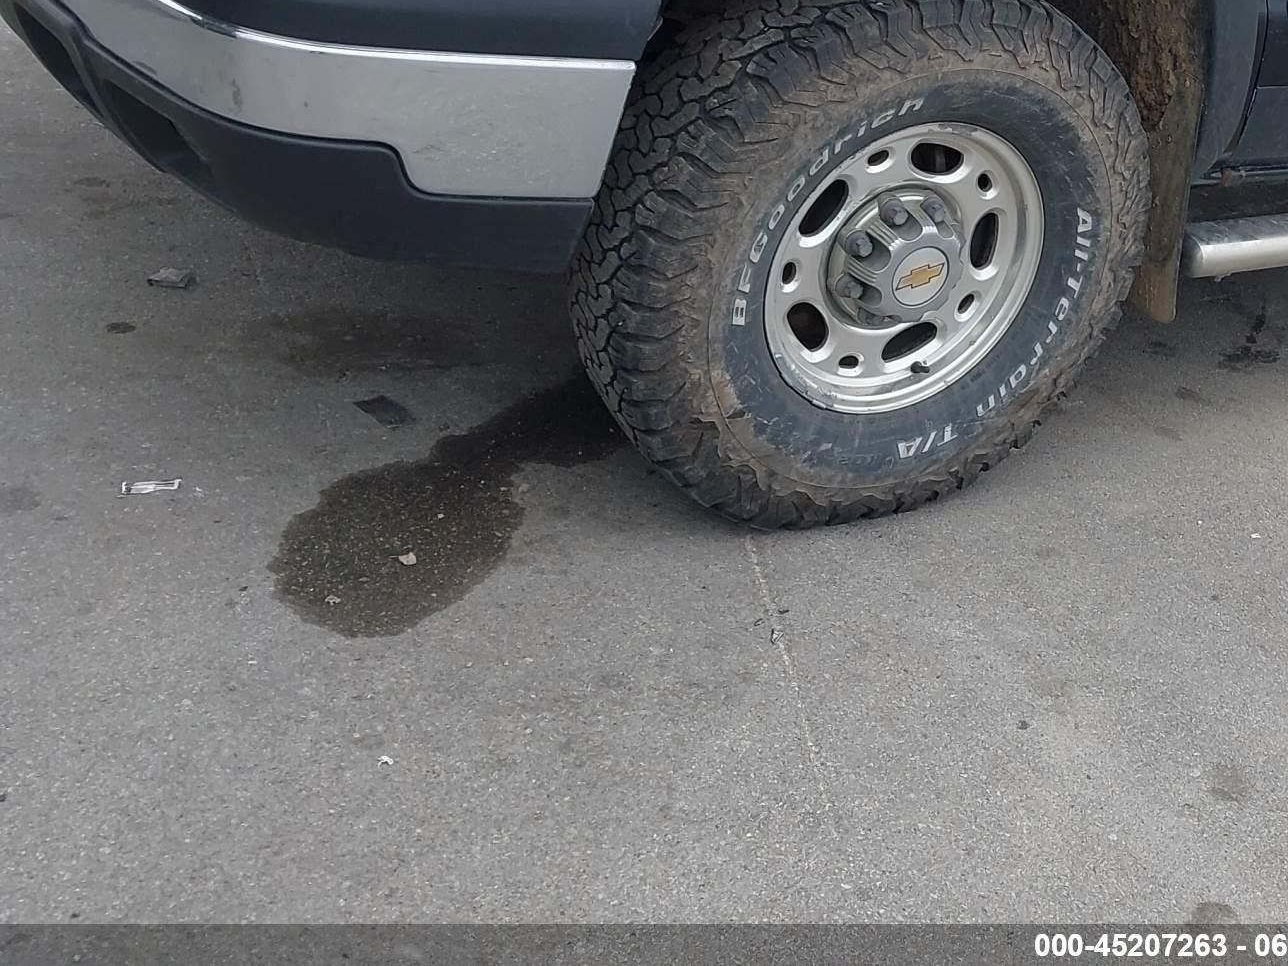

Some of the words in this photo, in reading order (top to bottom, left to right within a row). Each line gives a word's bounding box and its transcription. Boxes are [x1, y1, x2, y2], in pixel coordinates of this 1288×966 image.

[732, 97, 924, 326] BFGoodrich
[976, 206, 1093, 418] All-Terrain
[897, 423, 958, 459] T/A
